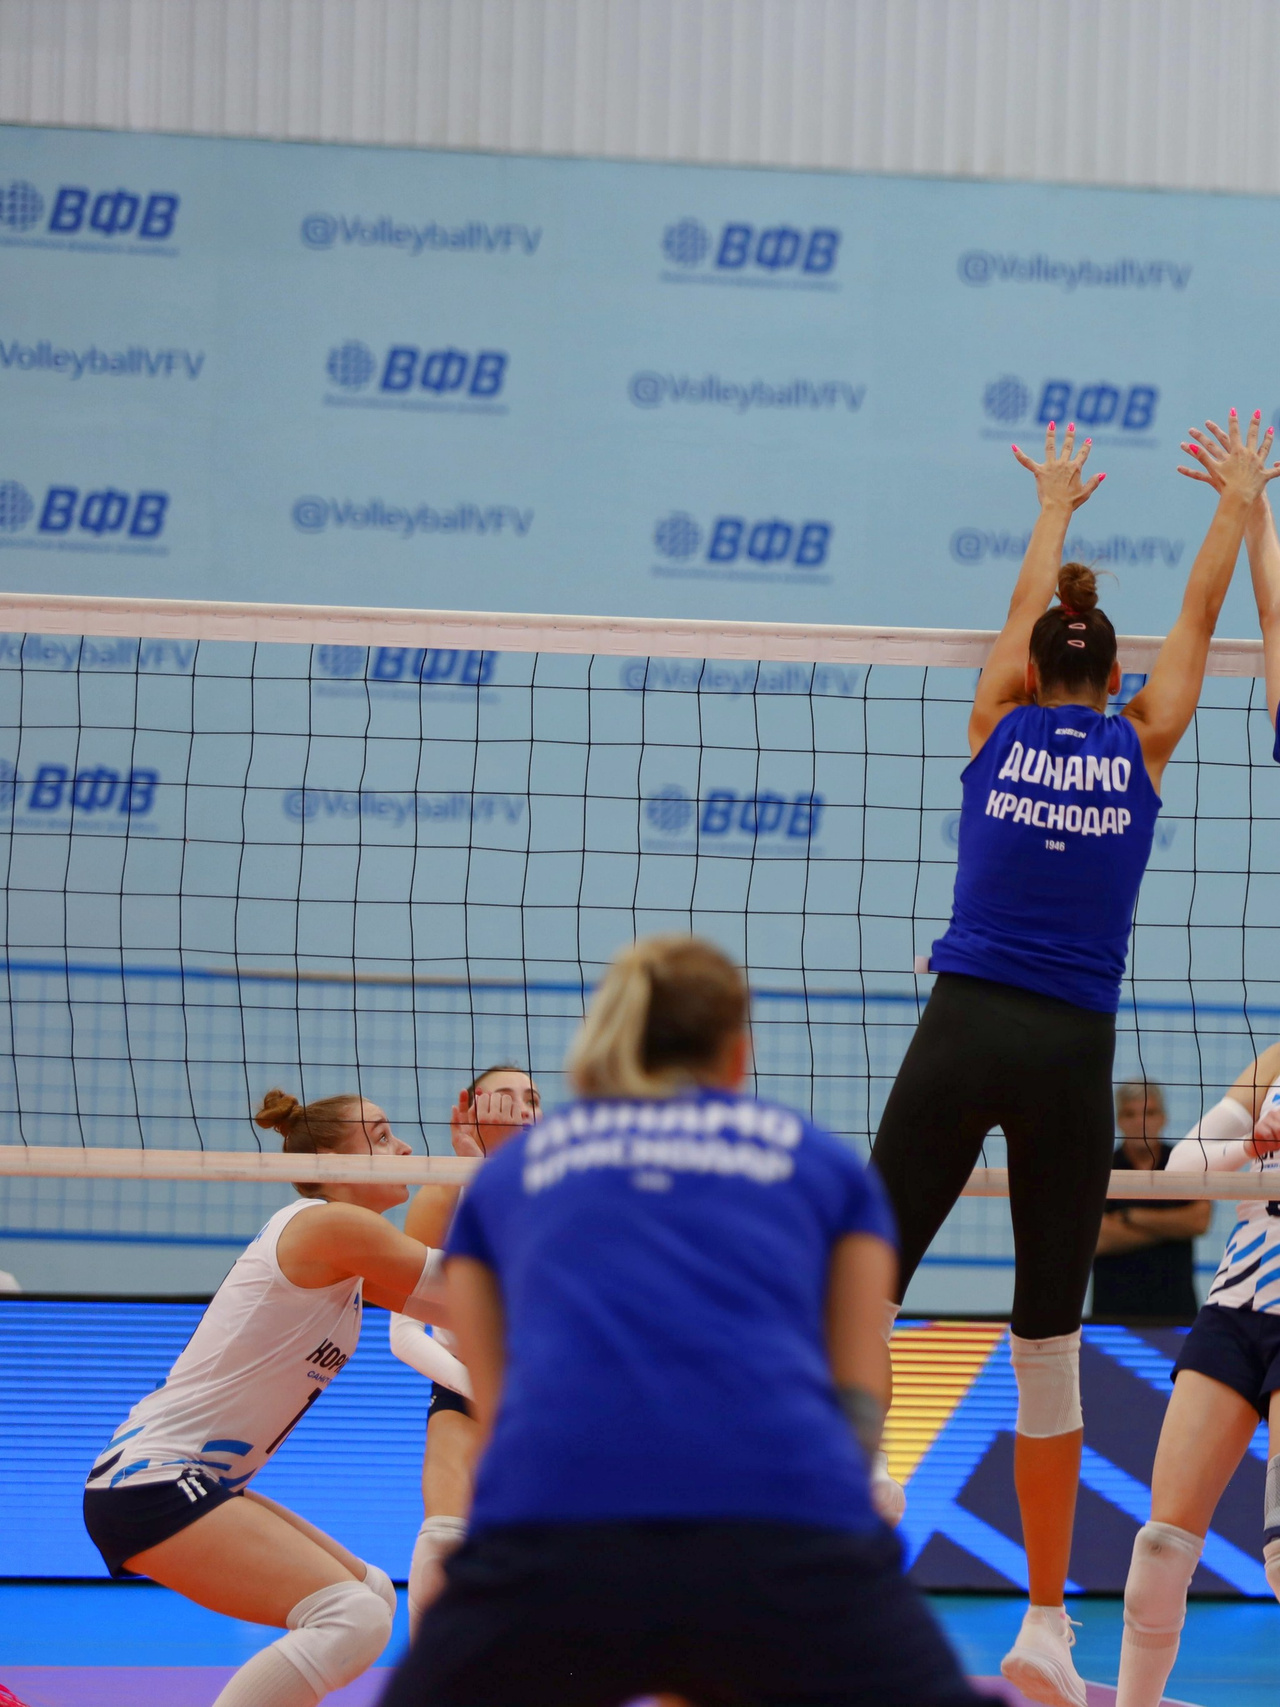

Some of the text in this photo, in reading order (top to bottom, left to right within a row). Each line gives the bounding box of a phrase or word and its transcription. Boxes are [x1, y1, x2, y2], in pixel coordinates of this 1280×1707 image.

[47, 185, 180, 241] ВФВ
[301, 213, 542, 256] @VolleyballVFV
[714, 222, 841, 275] ВФВ
[380, 345, 509, 398] ВФВ
[1034, 380, 1160, 432] ВФВ
[38, 485, 170, 540] ВФВ
[291, 494, 533, 538] @VolleyballVFV
[707, 515, 833, 569] ВФВ
[28, 763, 161, 817] ВФВ
[998, 741, 1131, 792] ДИНАМО
[699, 788, 826, 838] ВФВ
[985, 790, 1131, 837] КРАСНОДАР
[1045, 840, 1065, 851] 1946
